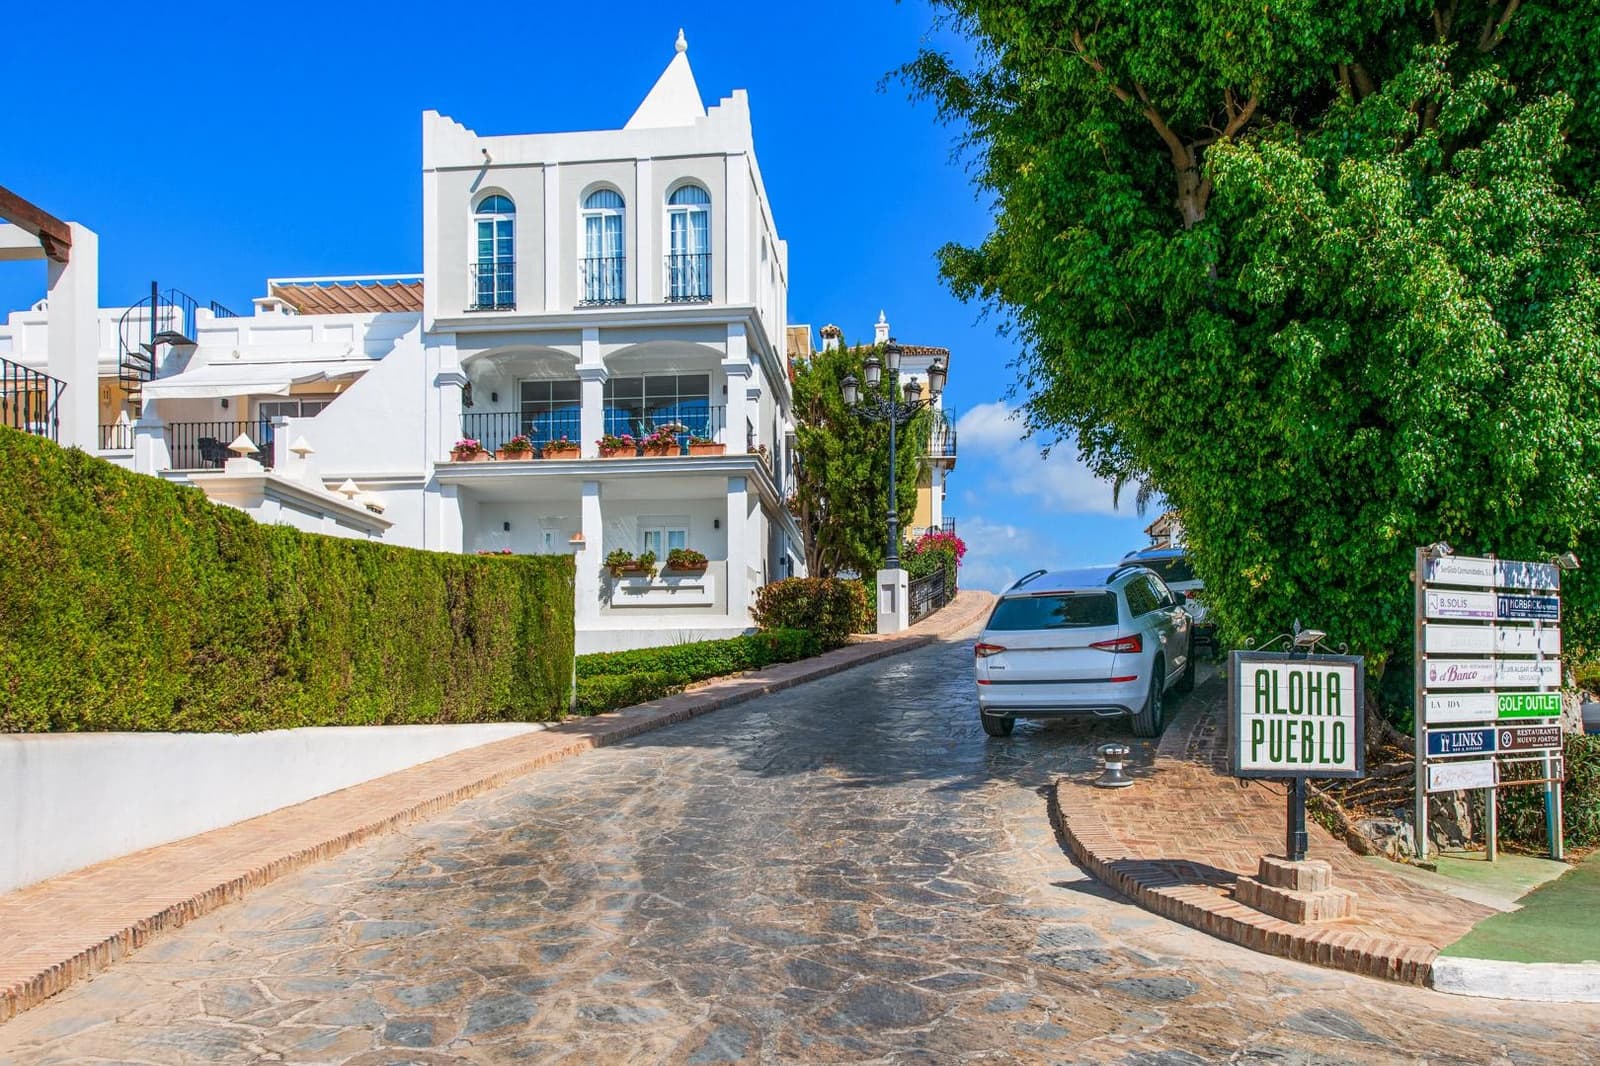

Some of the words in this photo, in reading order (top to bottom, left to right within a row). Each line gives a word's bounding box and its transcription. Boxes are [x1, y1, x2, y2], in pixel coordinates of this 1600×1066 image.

[1447, 664, 1478, 682] Banco
[1254, 669, 1342, 716] ALOHA
[1498, 696, 1523, 712] GOLF
[1525, 695, 1560, 711] OUTLET
[1452, 732, 1483, 747] LINKS
[1517, 728, 1558, 736] RESTAURANTE
[1517, 736, 1537, 744] NUEVO
[1251, 719, 1345, 764] PUEBLO
